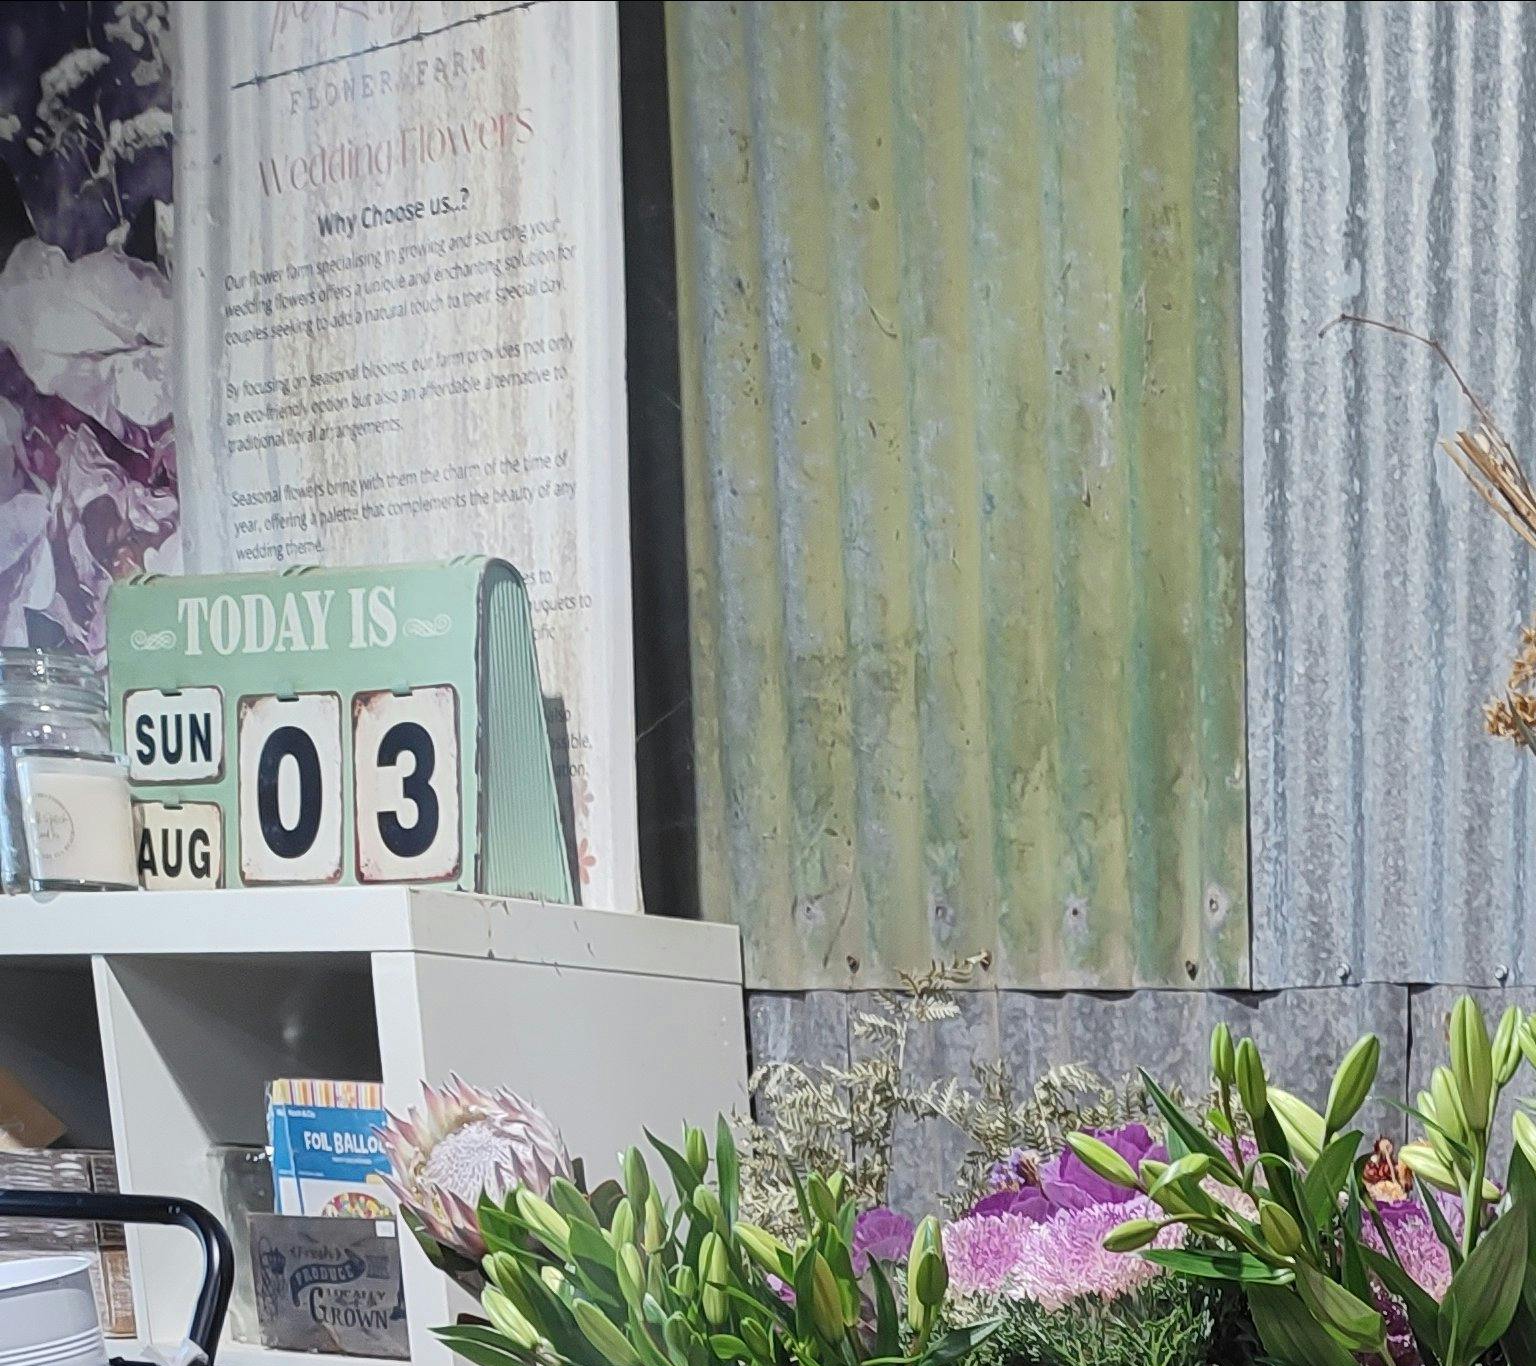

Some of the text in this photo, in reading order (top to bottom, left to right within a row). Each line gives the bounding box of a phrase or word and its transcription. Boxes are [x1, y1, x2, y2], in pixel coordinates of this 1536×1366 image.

[288, 46, 487, 116] FLOWER FARM
[258, 108, 535, 197] Wedding Flowers
[318, 212, 357, 239] Why
[361, 200, 425, 229] Choose
[224, 274, 247, 292] Our
[250, 269, 283, 288] flower
[400, 239, 447, 265] growing
[449, 229, 473, 251] and
[224, 298, 273, 318] wedding
[230, 485, 281, 508] Seasonal
[283, 481, 325, 500] flowers
[326, 476, 357, 498] bring
[359, 471, 385, 493] with
[386, 470, 418, 489] them
[420, 466, 440, 484] the
[484, 457, 498, 476] of
[499, 454, 520, 474] the
[553, 448, 569, 468] of
[264, 511, 307, 532] offering
[318, 506, 359, 529] palette
[361, 502, 386, 520] that
[387, 494, 467, 517] complements
[469, 488, 490, 507] the
[492, 485, 534, 507] beauty
[554, 481, 577, 501] any
[234, 540, 284, 562] wedding
[178, 584, 397, 656] TODAY IS
[134, 711, 213, 767] SUN
[137, 827, 211, 880] AUG
[303, 1130, 333, 1153] FOIL
[309, 1286, 388, 1330] GROWN
